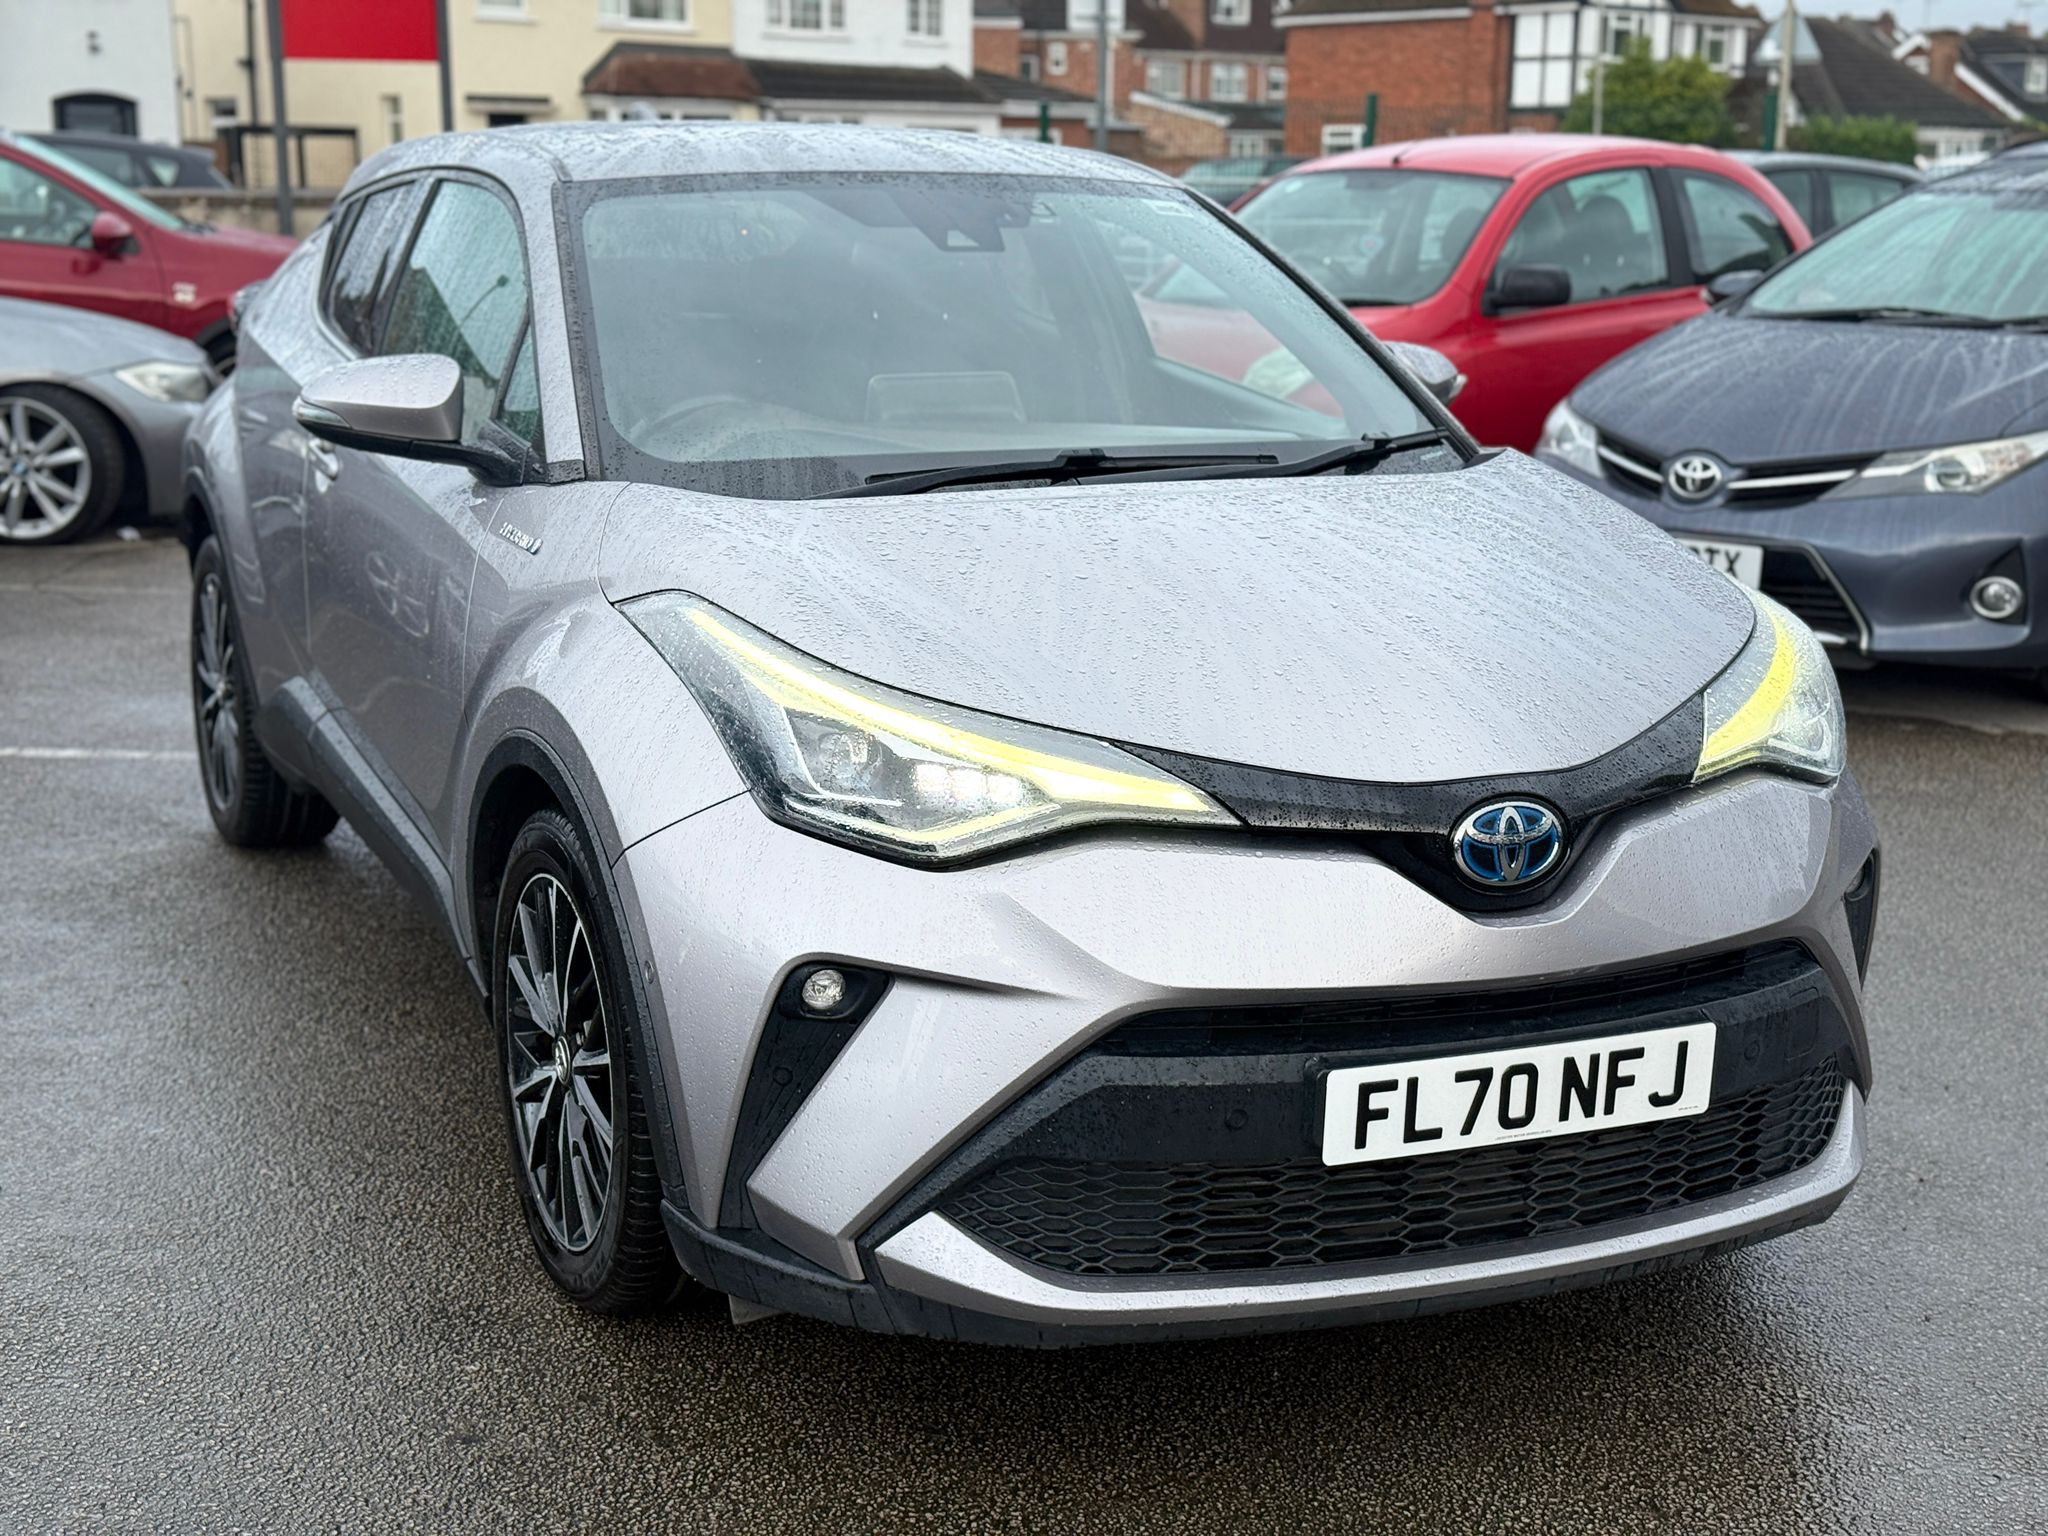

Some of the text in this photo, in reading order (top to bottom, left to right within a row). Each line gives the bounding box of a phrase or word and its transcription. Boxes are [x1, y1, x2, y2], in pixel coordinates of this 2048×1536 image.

[1687, 546, 1741, 579] TX
[1354, 1040, 1689, 1150] FL70 NFJ
